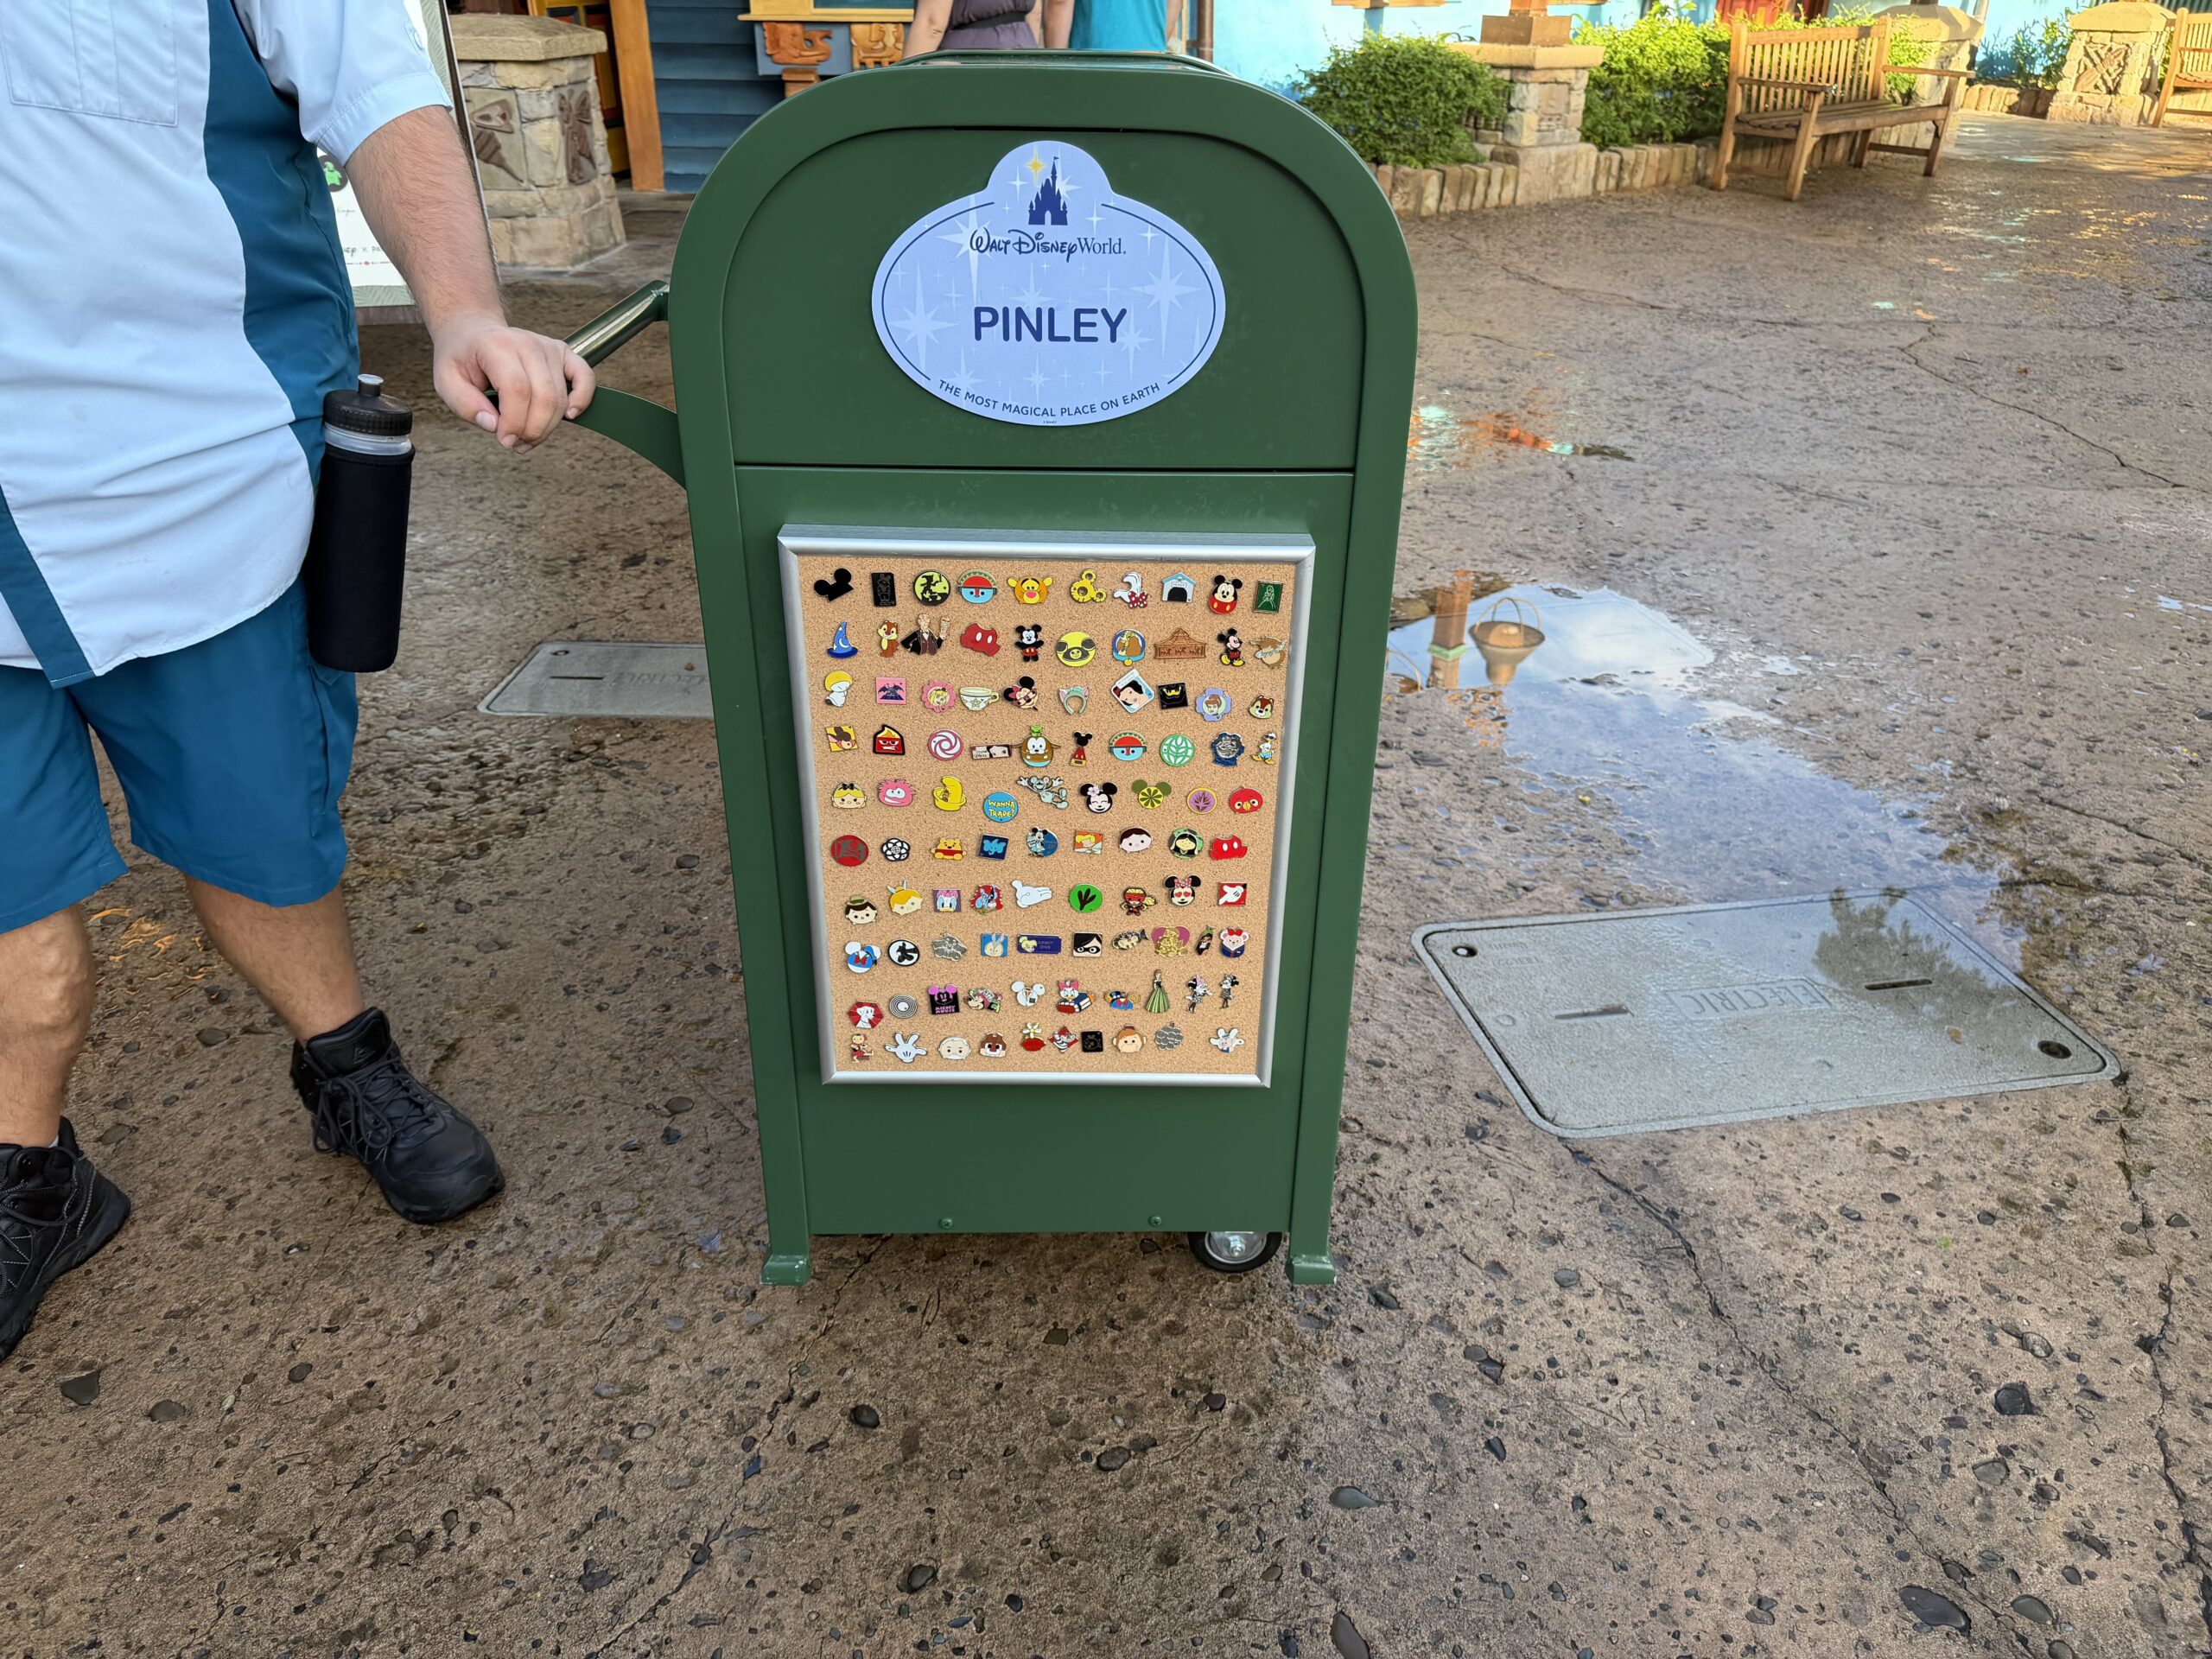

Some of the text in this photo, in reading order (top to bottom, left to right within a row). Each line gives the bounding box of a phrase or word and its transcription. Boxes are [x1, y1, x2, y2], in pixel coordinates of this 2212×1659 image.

[974, 306, 1128, 343] PINLEY
[938, 378, 1160, 417] THE MOST MAGICAL PLACE ON EARTH
[988, 798, 1015, 809] WANNA
[988, 808, 1015, 817] TRADE?
[1681, 984, 1823, 1014] ELECTRIC
